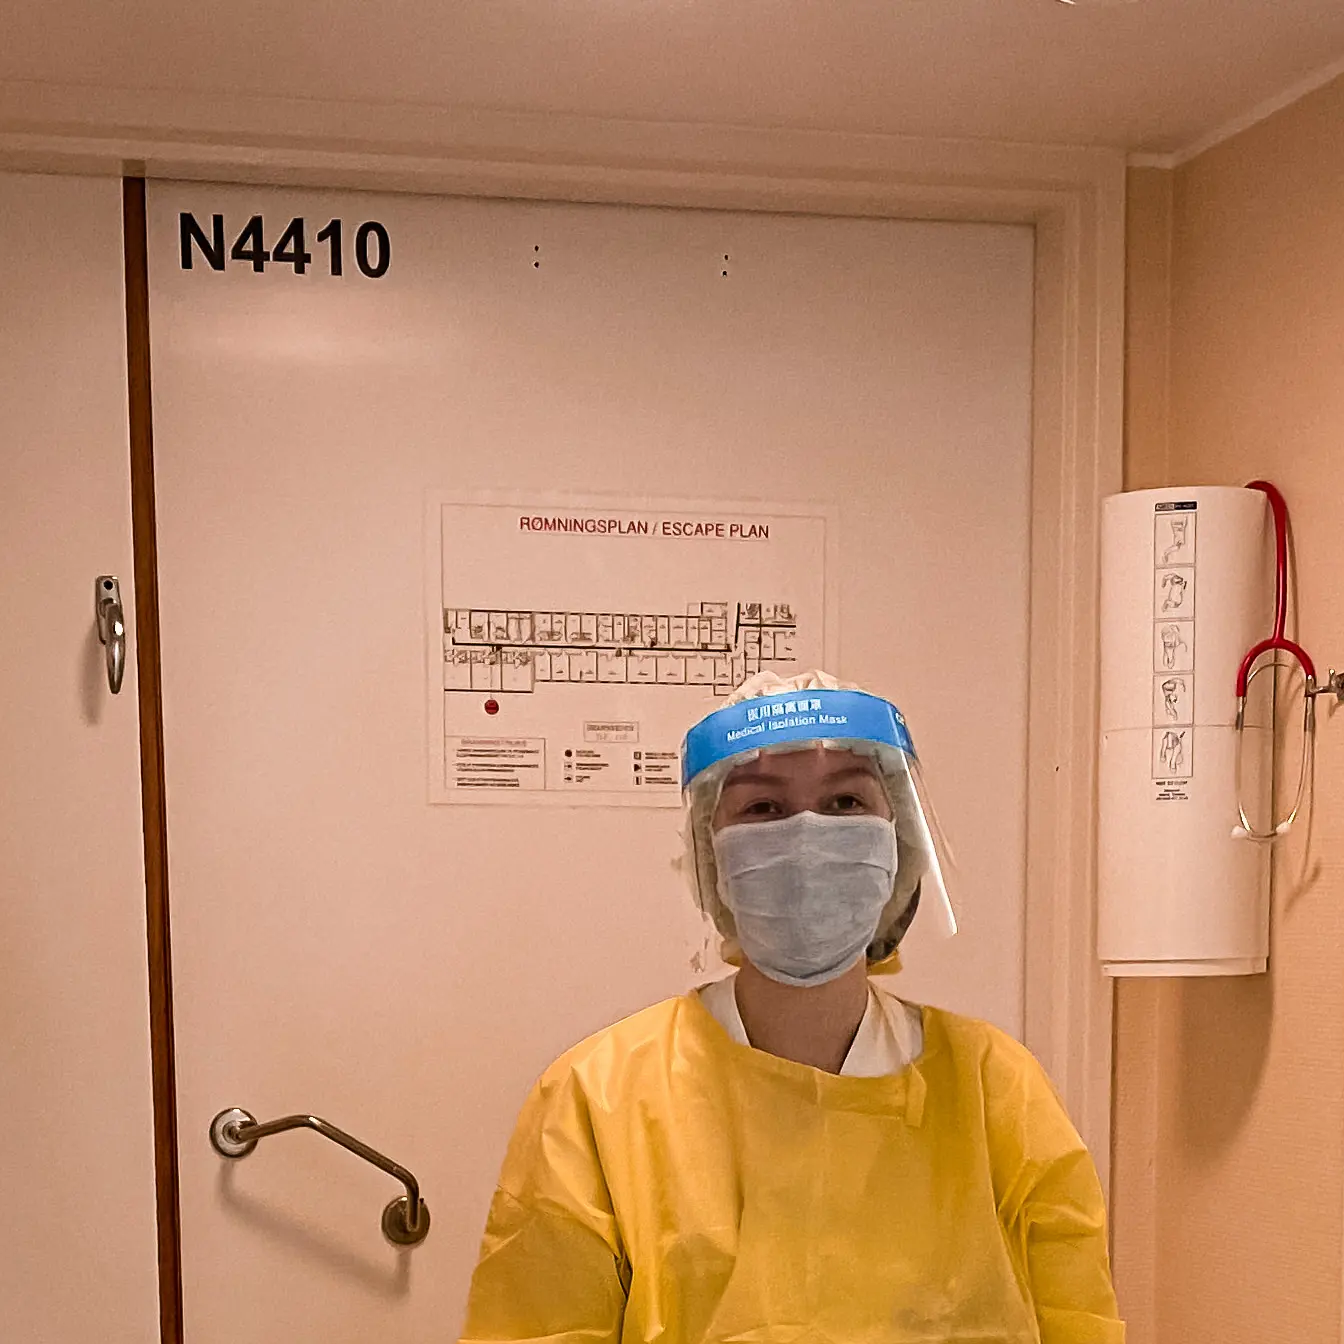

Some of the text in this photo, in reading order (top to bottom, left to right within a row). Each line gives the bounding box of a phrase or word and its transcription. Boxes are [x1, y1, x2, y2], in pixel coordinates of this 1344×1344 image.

[179, 212, 391, 279] N4410
[519, 516, 769, 539] RØMNINGSPLAN / ESCAPE PLAN
[727, 714, 848, 742] Medical Isolation Mask
